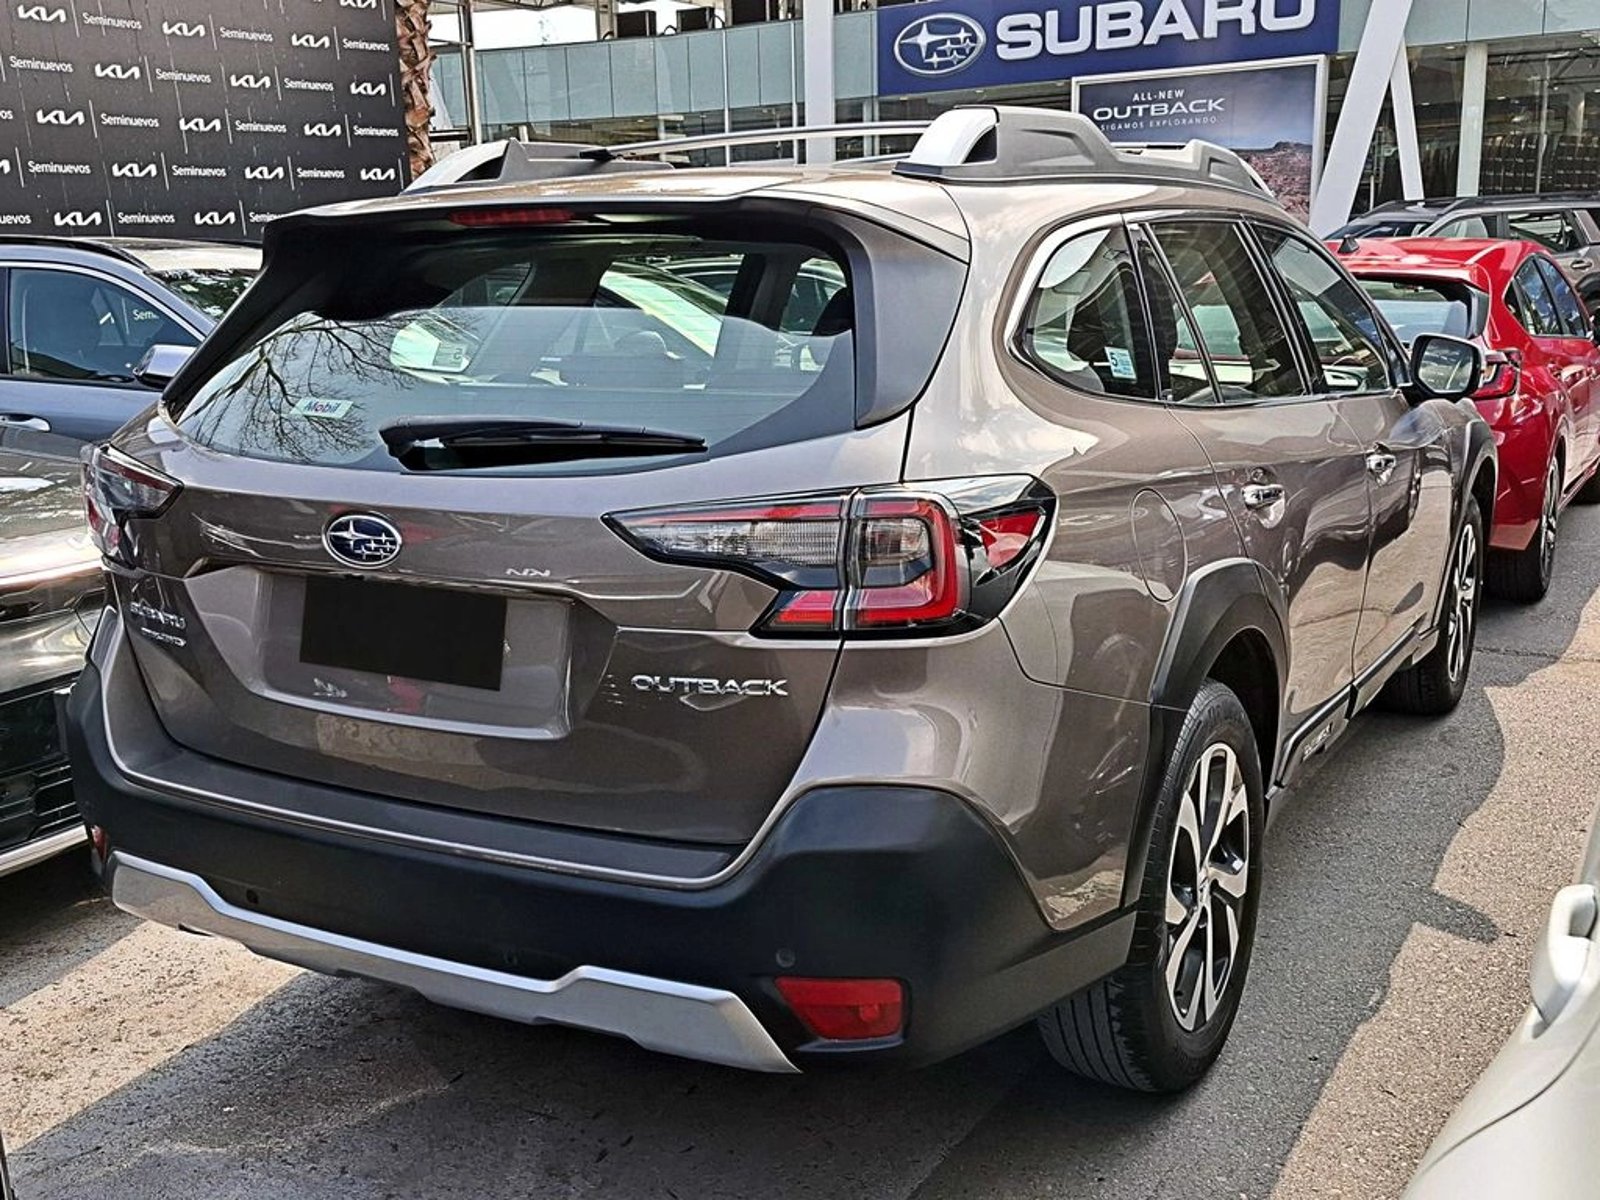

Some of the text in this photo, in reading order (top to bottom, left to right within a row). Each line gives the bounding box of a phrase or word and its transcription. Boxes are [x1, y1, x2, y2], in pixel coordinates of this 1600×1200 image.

[82, 12, 142, 30] Seminuevos
[219, 26, 273, 42] Seminuevos
[996, 0, 1316, 61] SUBARU
[342, 38, 390, 52] Seminuevos
[9, 55, 73, 73] Seminuevos
[155, 68, 212, 84] Seminuevos
[283, 78, 334, 92] Seminuevos
[1132, 89, 1185, 102] ALL-NEW
[1093, 98, 1226, 121] OUTBACK
[100, 113, 160, 128] Seminuevos
[235, 120, 287, 133] Seminuevos
[1100, 115, 1217, 131] SIGAMOS EXPLORANDO
[353, 125, 399, 138] Seminuevos
[27, 161, 91, 175] Seminuevos
[171, 165, 226, 178] Seminuevos
[296, 168, 345, 180] Seminuevos
[0, 214, 32, 225] uevos
[118, 213, 175, 226] Seminuevos
[304, 401, 341, 413] Mobil
[631, 674, 788, 696] OUTBACK
